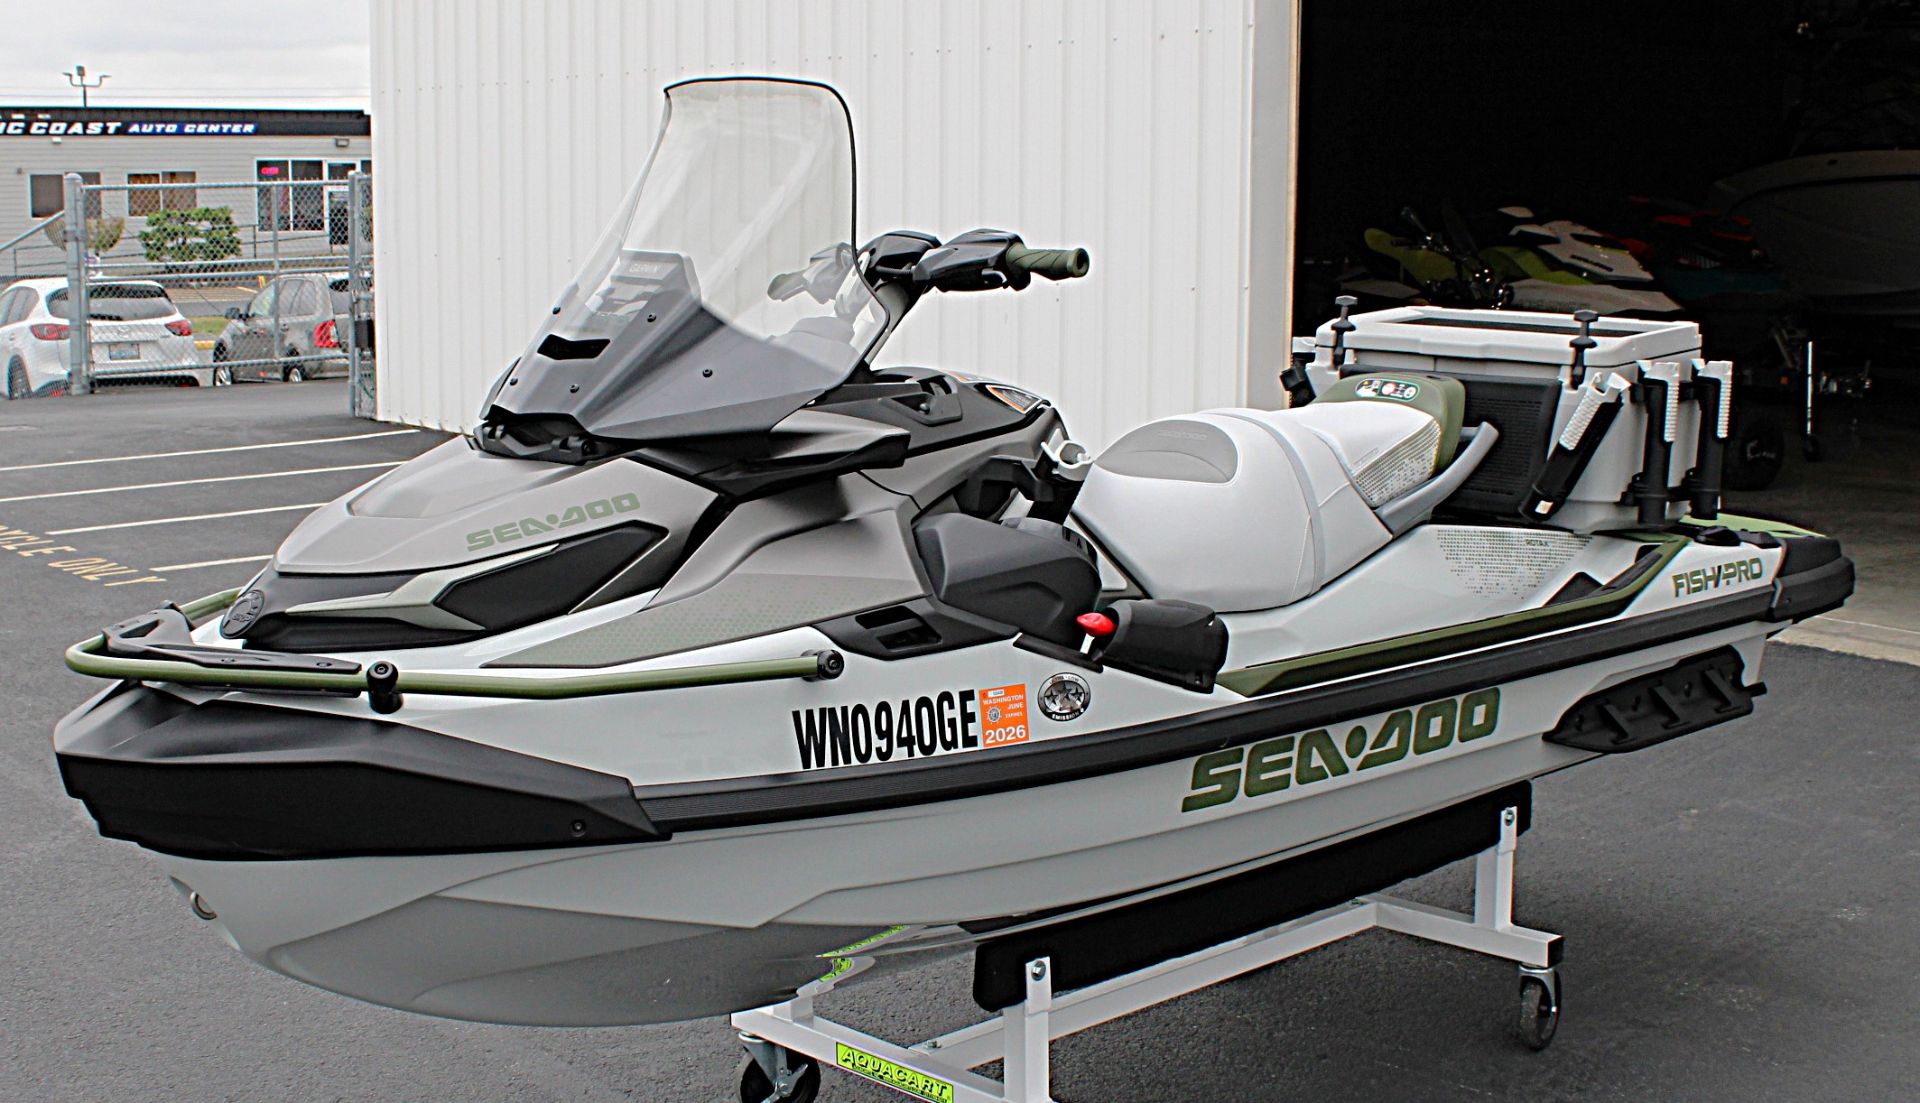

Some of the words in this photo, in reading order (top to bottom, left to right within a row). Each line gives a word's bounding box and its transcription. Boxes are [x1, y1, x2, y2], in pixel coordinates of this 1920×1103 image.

[29, 122, 122, 135] COAST
[127, 123, 178, 133] AUTO
[184, 123, 255, 133] CENTER
[48, 557, 167, 587] ONLY
[982, 694, 1024, 705] WASHINGTON
[1007, 702, 1025, 710] JUNE
[985, 724, 1027, 744] 2026
[841, 1050, 948, 1098] AQUACART
